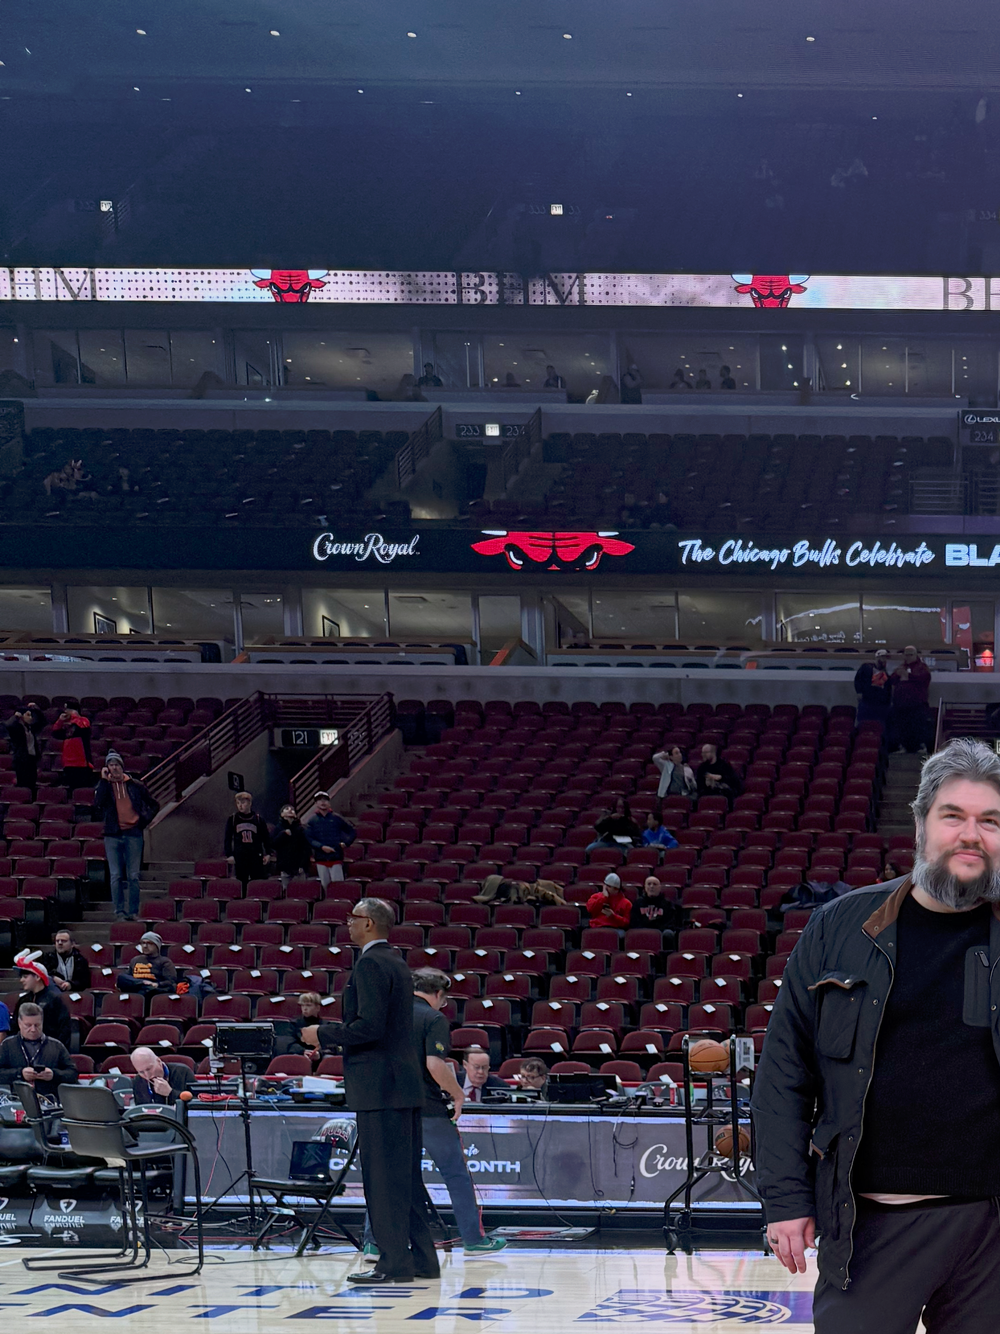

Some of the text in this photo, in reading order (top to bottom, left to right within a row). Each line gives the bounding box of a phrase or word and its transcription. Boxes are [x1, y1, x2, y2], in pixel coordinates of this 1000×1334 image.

[8, 267, 97, 301] HM
[456, 271, 586, 305] BHM
[313, 532, 420, 563] Crown Royal
[678, 539, 716, 565] The
[718, 539, 791, 570] Chicago
[792, 538, 842, 567] Bulls
[845, 541, 936, 567] Celebrate
[291, 730, 308, 744] 121
[467, 1160, 521, 1174] ONTH
[43, 1214, 86, 1224] FANDUEL
[0, 1282, 556, 1299] NITED
